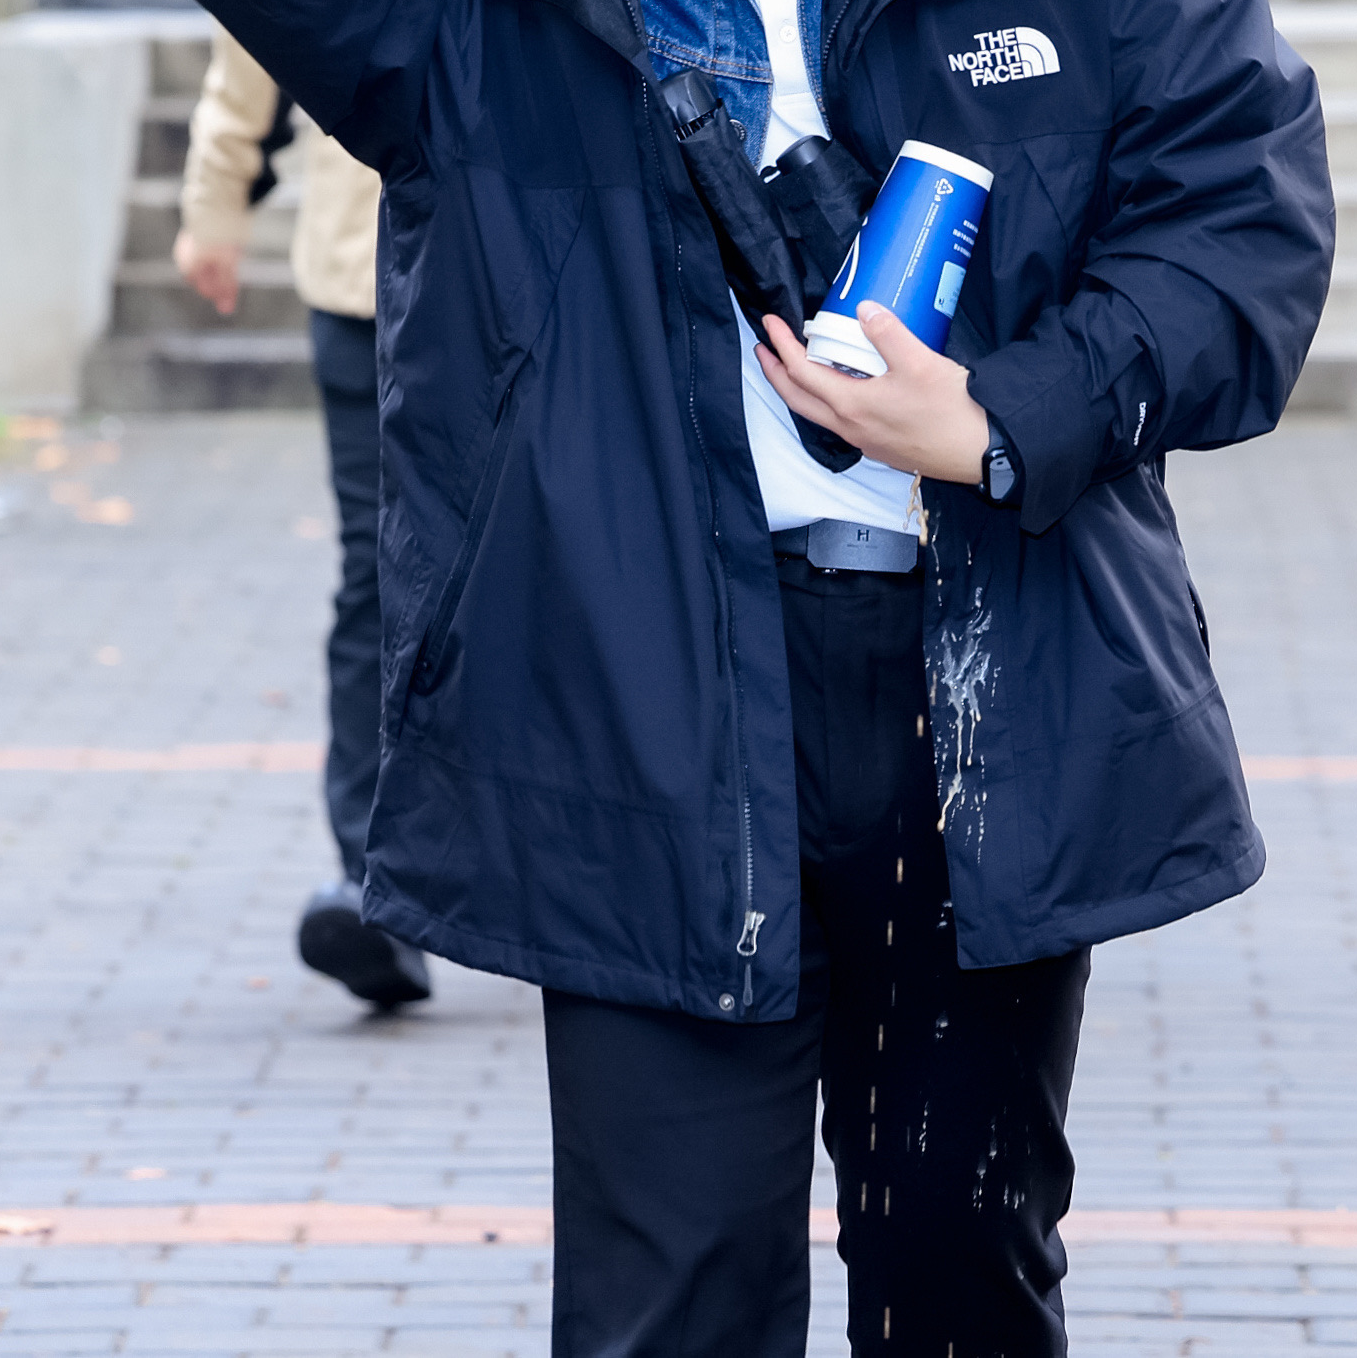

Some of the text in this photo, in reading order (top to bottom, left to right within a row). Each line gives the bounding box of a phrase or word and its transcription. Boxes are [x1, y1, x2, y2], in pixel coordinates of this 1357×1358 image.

[973, 28, 1018, 51] THE
[948, 45, 1021, 72] NORTH
[970, 62, 1024, 87] FACE
